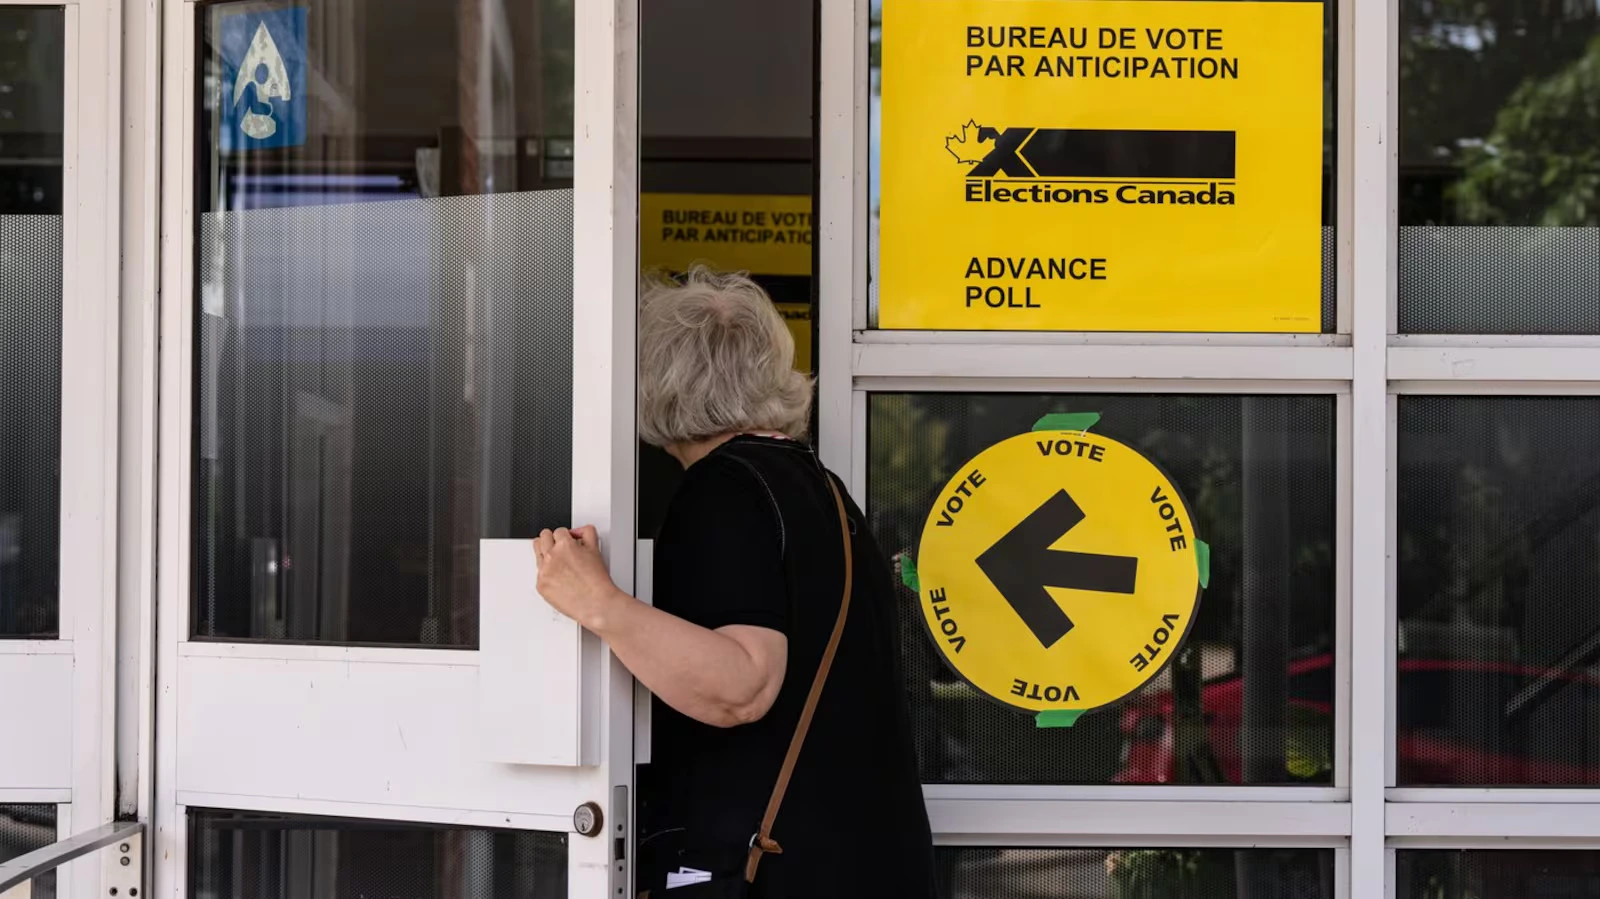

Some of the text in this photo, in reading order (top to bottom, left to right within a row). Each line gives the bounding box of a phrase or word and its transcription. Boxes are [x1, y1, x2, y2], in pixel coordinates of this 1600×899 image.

[966, 26, 1223, 51] BUREAU DE VOTE
[966, 55, 1239, 80] PAR ANTICIPATION
[965, 179, 1236, 205] Elections Canada
[662, 210, 737, 225] BUREAU
[742, 212, 766, 226] DE
[661, 228, 699, 242] PAR
[964, 257, 1107, 280] ADVANCE
[965, 286, 1041, 308] POLL
[1036, 439, 1106, 463] VOTE
[936, 469, 987, 528] VOTE
[1150, 486, 1187, 552] VOTE
[929, 587, 967, 654] VOTE
[1129, 612, 1180, 672] VOTE
[1010, 678, 1081, 702] VOTE
